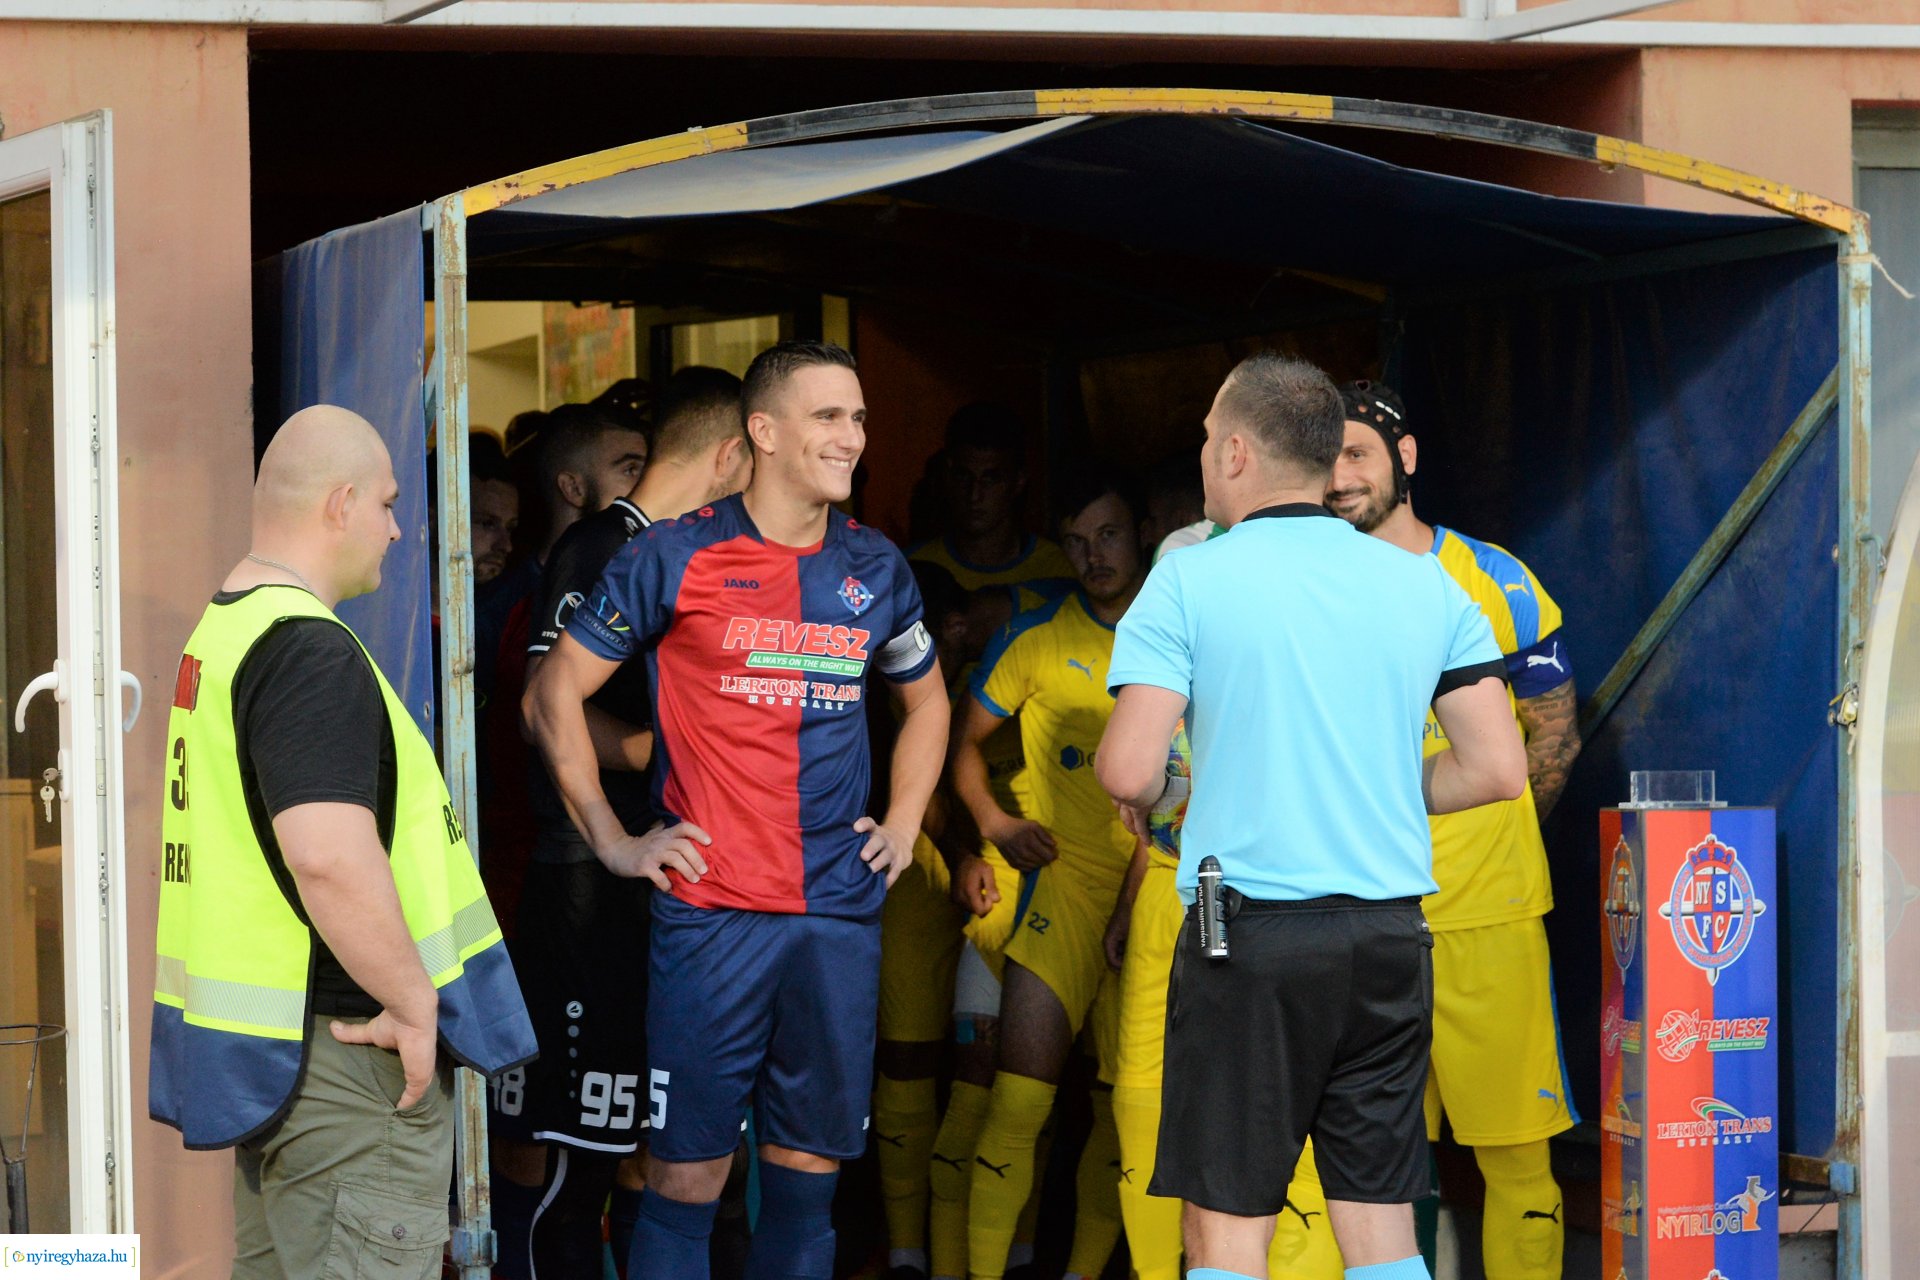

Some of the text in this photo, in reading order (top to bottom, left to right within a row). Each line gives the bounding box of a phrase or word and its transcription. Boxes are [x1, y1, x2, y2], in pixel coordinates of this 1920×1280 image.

[724, 578, 760, 590] JAKO
[751, 654, 861, 673] ALWAYS ON THE RIGHT WAY
[720, 676, 861, 702] LERTON TRANS
[749, 695, 845, 711] HUNGARY
[1027, 911, 1049, 935] 22
[580, 1071, 638, 1130] 95
[1657, 1120, 1718, 1139] LERTON
[1721, 1116, 1772, 1135] TRANS
[1677, 1135, 1753, 1148] HUNGARY
